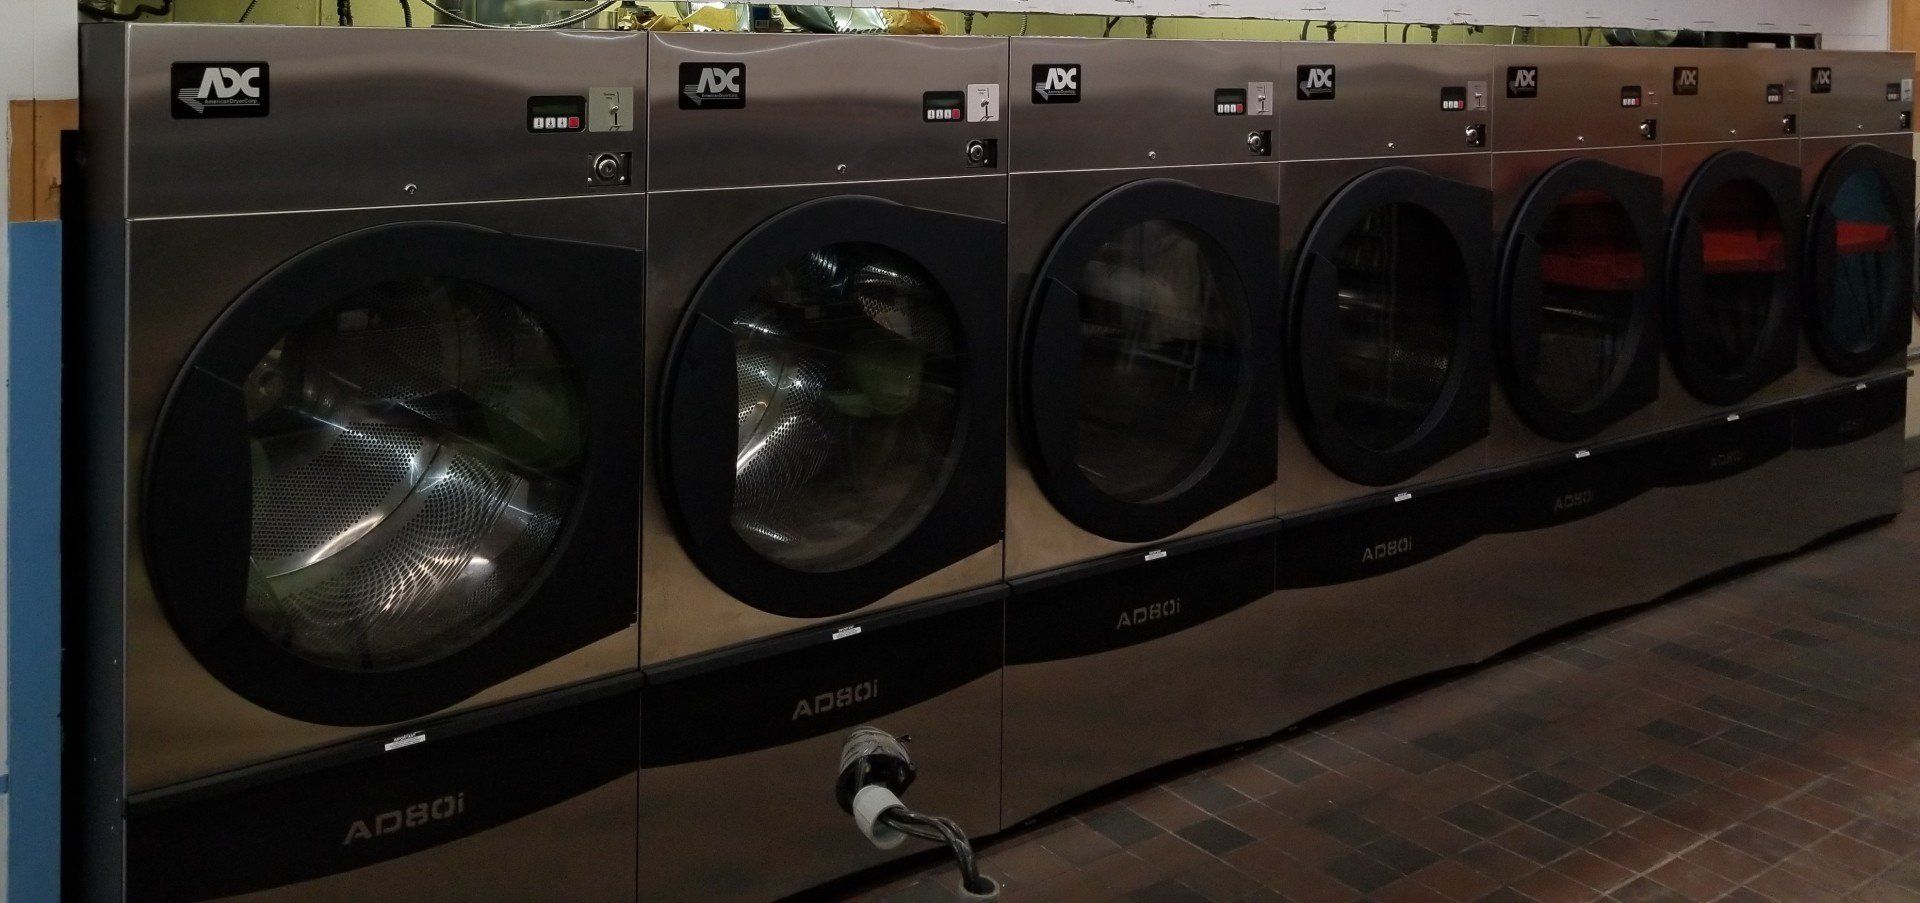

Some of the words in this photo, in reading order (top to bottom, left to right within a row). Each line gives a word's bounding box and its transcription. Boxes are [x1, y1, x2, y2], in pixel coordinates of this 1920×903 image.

[197, 67, 260, 98] ADC
[697, 67, 740, 93] ADC
[1045, 67, 1077, 90] ADC
[1307, 68, 1332, 88] ADC
[1515, 69, 1536, 87] ADC
[1361, 536, 1412, 563] AD80i
[1116, 597, 1180, 631] AD80i
[791, 679, 878, 721] AD80i
[341, 791, 465, 845] AD80i
